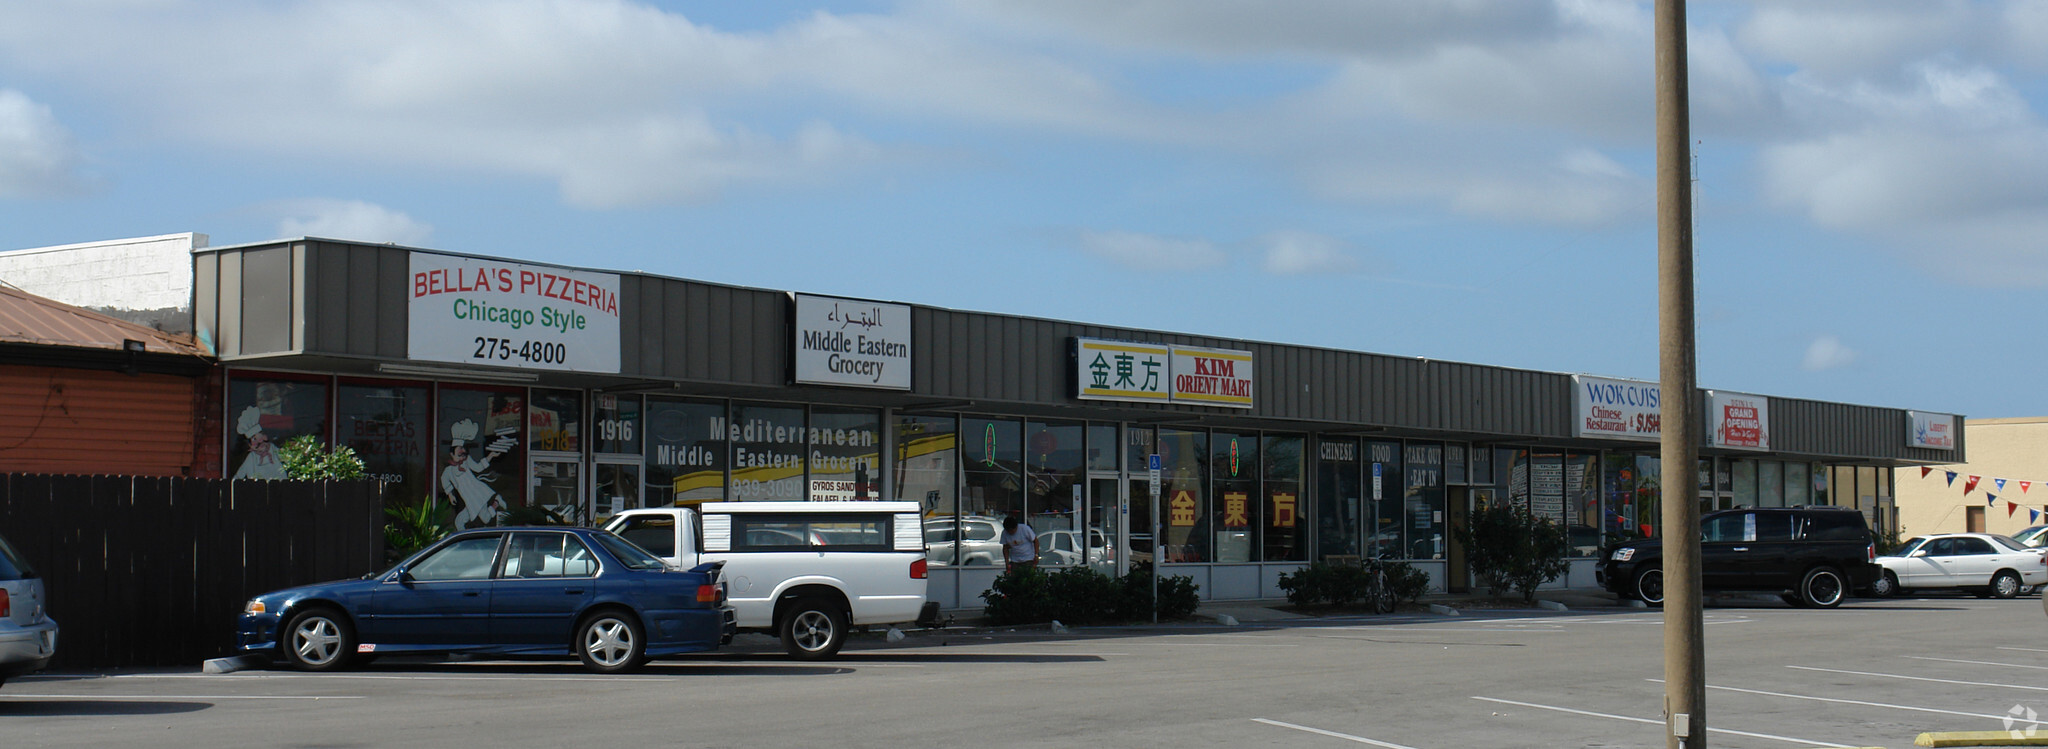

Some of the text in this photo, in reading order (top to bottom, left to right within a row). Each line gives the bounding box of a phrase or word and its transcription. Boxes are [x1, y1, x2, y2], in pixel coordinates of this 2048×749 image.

[415, 268, 618, 317] BELLA'S PIZZERIA
[453, 298, 586, 333] Chicago Style
[473, 336, 566, 364] 275-4800
[803, 329, 907, 358] Middle Eastern
[828, 353, 884, 383] Grocery
[1089, 351, 1161, 392] 金東方
[1194, 357, 1235, 378] KIM
[1176, 374, 1251, 398] ORIENT MART
[1586, 382, 1661, 408] WOK CUISI
[1586, 417, 1627, 432] Restaurant
[1636, 412, 1661, 434] SUSH
[1591, 405, 1622, 420] Chinese
[1726, 418, 1758, 429] OPENING
[1729, 407, 1754, 418] GRAND
[540, 429, 570, 451] 1918
[598, 419, 633, 442] 1916
[710, 416, 872, 447] Mediterranean
[1130, 430, 1150, 446] 1912
[657, 444, 872, 475] Middle Eastern Grocery
[1320, 441, 1391, 463] CHINESE FOOD
[1407, 446, 1442, 465] TAKE OUT
[364, 473, 403, 483] 75-4800
[732, 478, 802, 496] 939-3090
[812, 481, 835, 491] GYROS
[1428, 469, 1437, 487] IN
